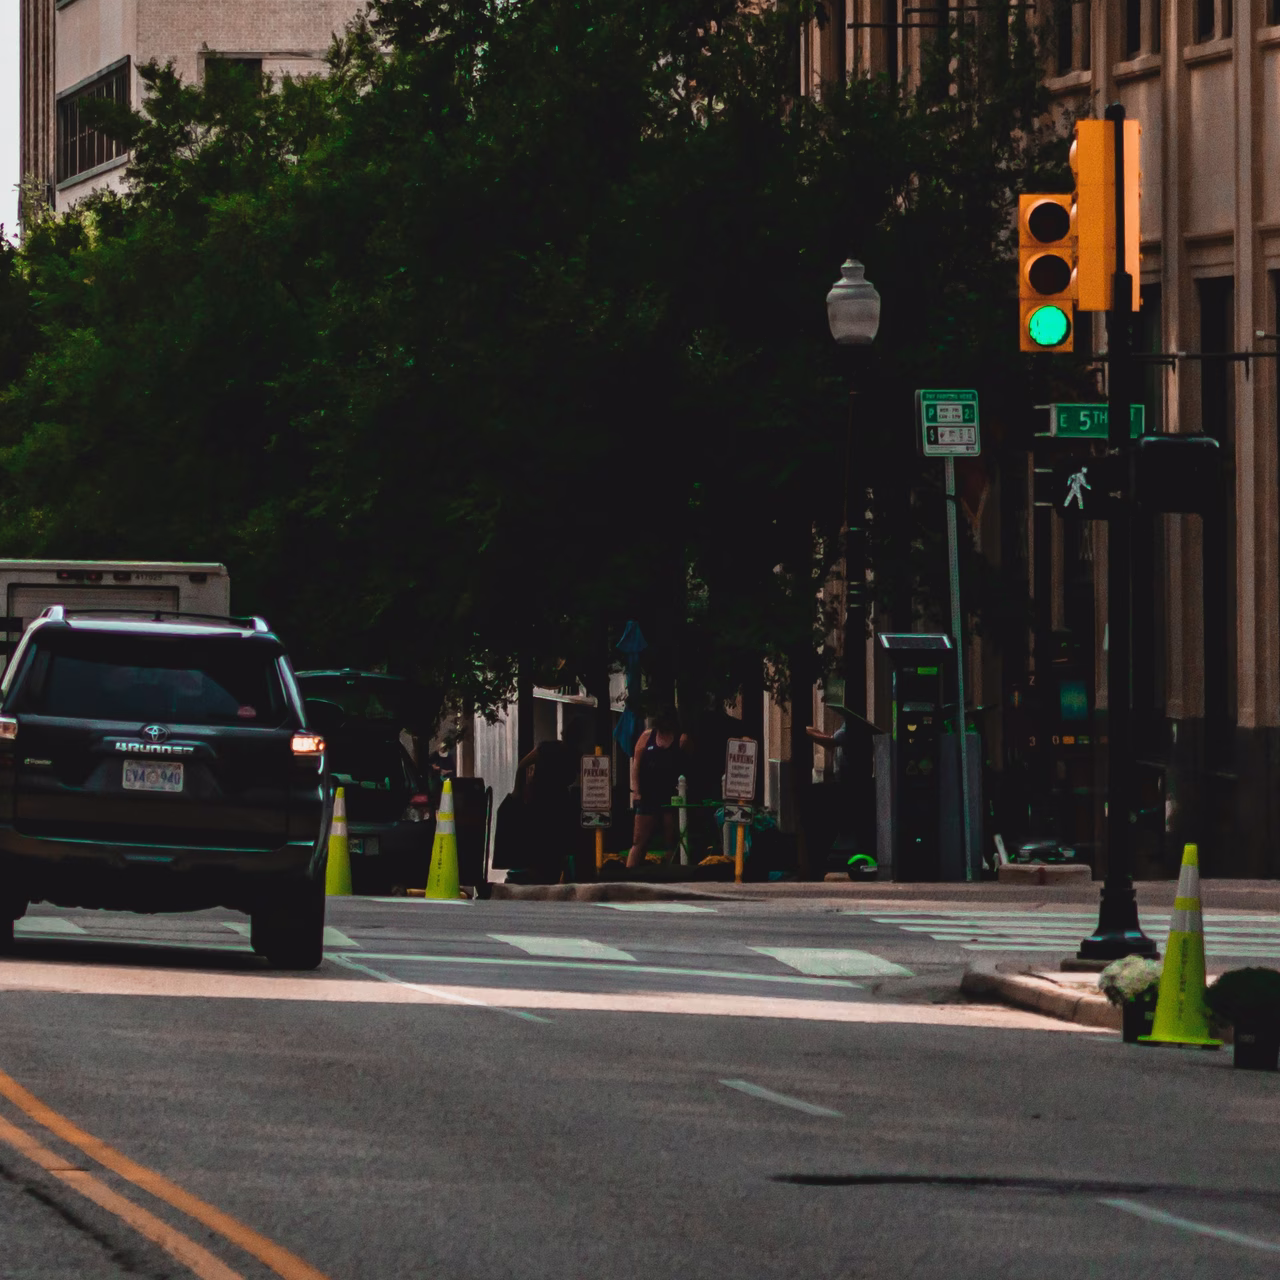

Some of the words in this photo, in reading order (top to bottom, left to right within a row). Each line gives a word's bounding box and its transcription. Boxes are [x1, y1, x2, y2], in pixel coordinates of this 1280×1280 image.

[1060, 415, 1067, 427] E
[1079, 411, 1108, 431] 5TH
[115, 742, 195, 755] 4RUNNER
[728, 753, 754, 764] PARKING
[584, 768, 608, 777] PARKING
